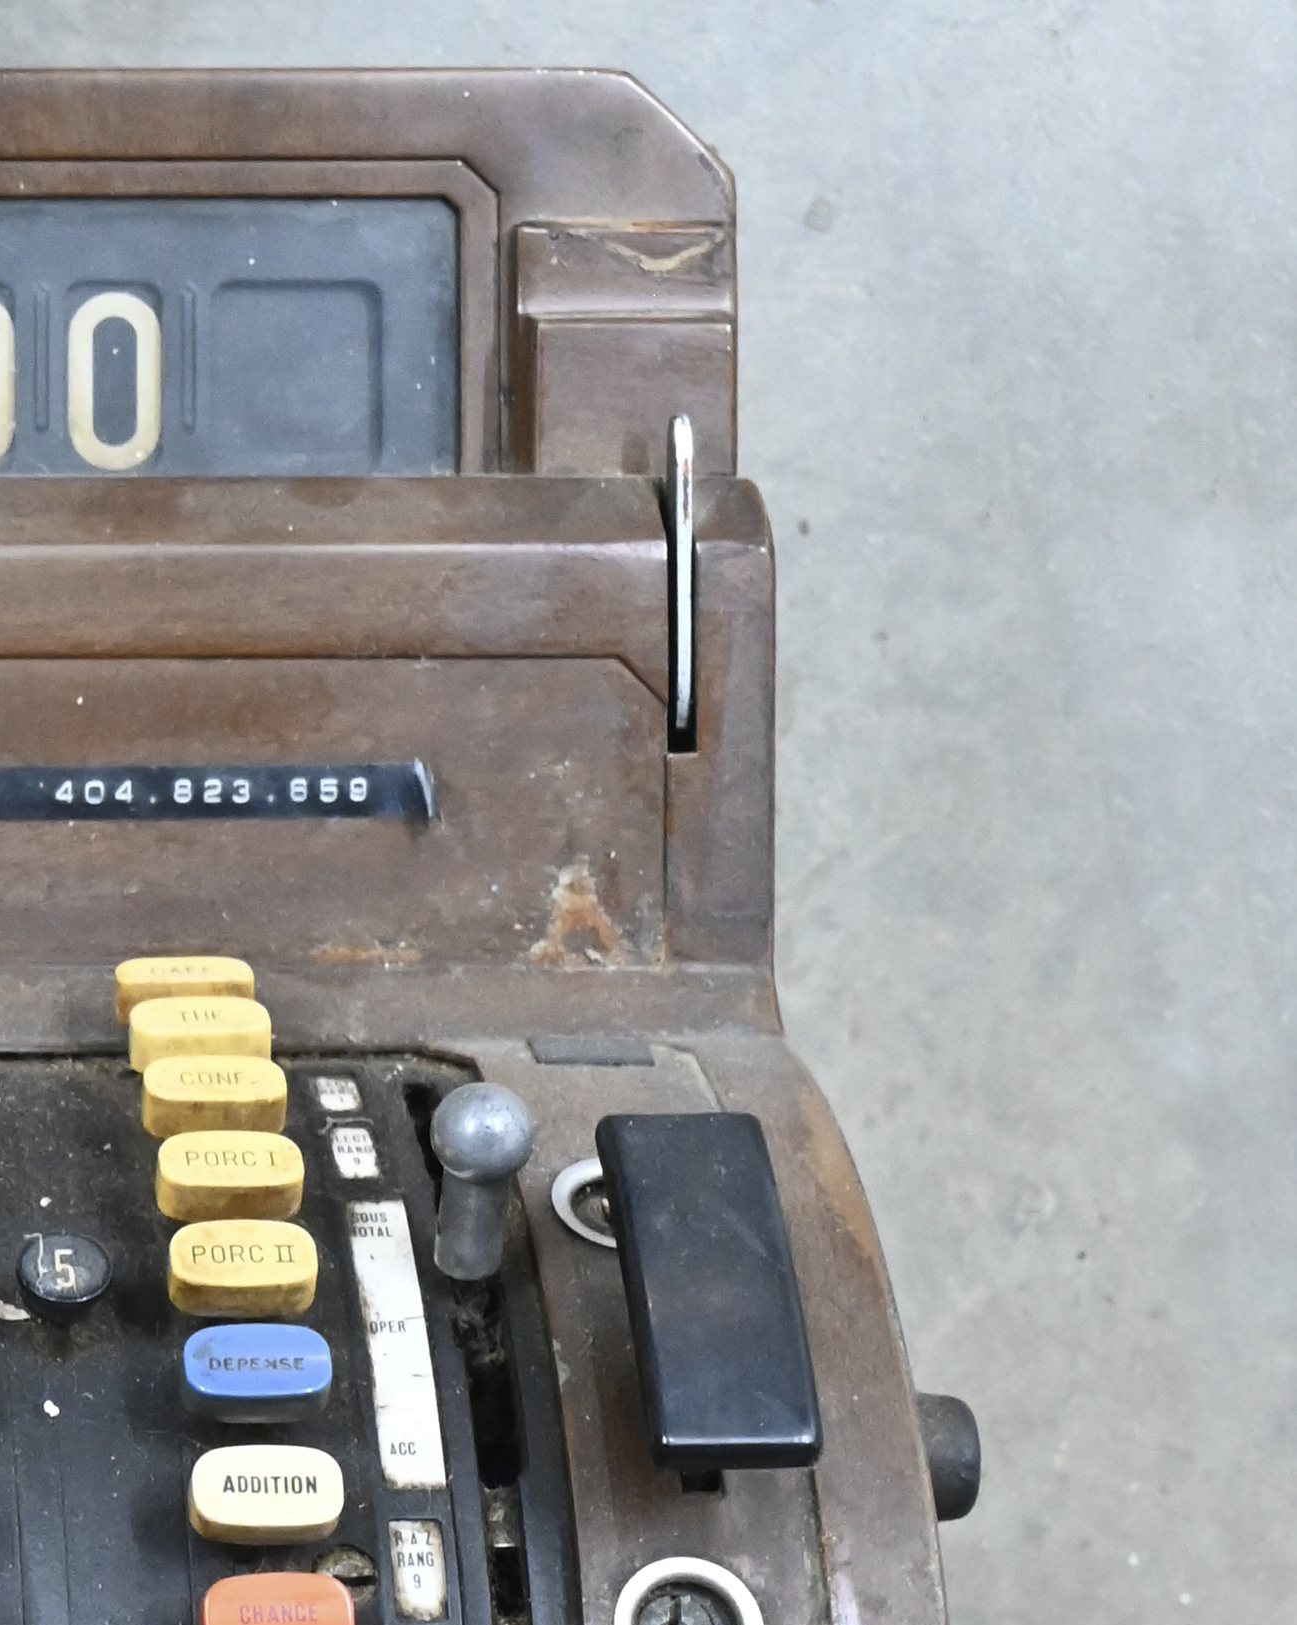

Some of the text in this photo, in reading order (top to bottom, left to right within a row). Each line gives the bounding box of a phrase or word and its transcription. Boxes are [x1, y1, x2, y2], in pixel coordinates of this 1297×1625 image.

[55, 777, 368, 804] 404.823.659
[185, 1150, 279, 1167] PORC I
[352, 1212, 388, 1222] SOUS
[192, 1244, 295, 1265] PORC II
[55, 1248, 75, 1288] 5
[370, 1320, 406, 1334] OPER
[209, 1357, 305, 1372] DEPENSE
[390, 1442, 417, 1456] ACC
[223, 1475, 318, 1495] ADDITION
[397, 1552, 435, 1567] RANG
[413, 1574, 422, 1589] 9
[239, 1605, 318, 1624] CHANGE
